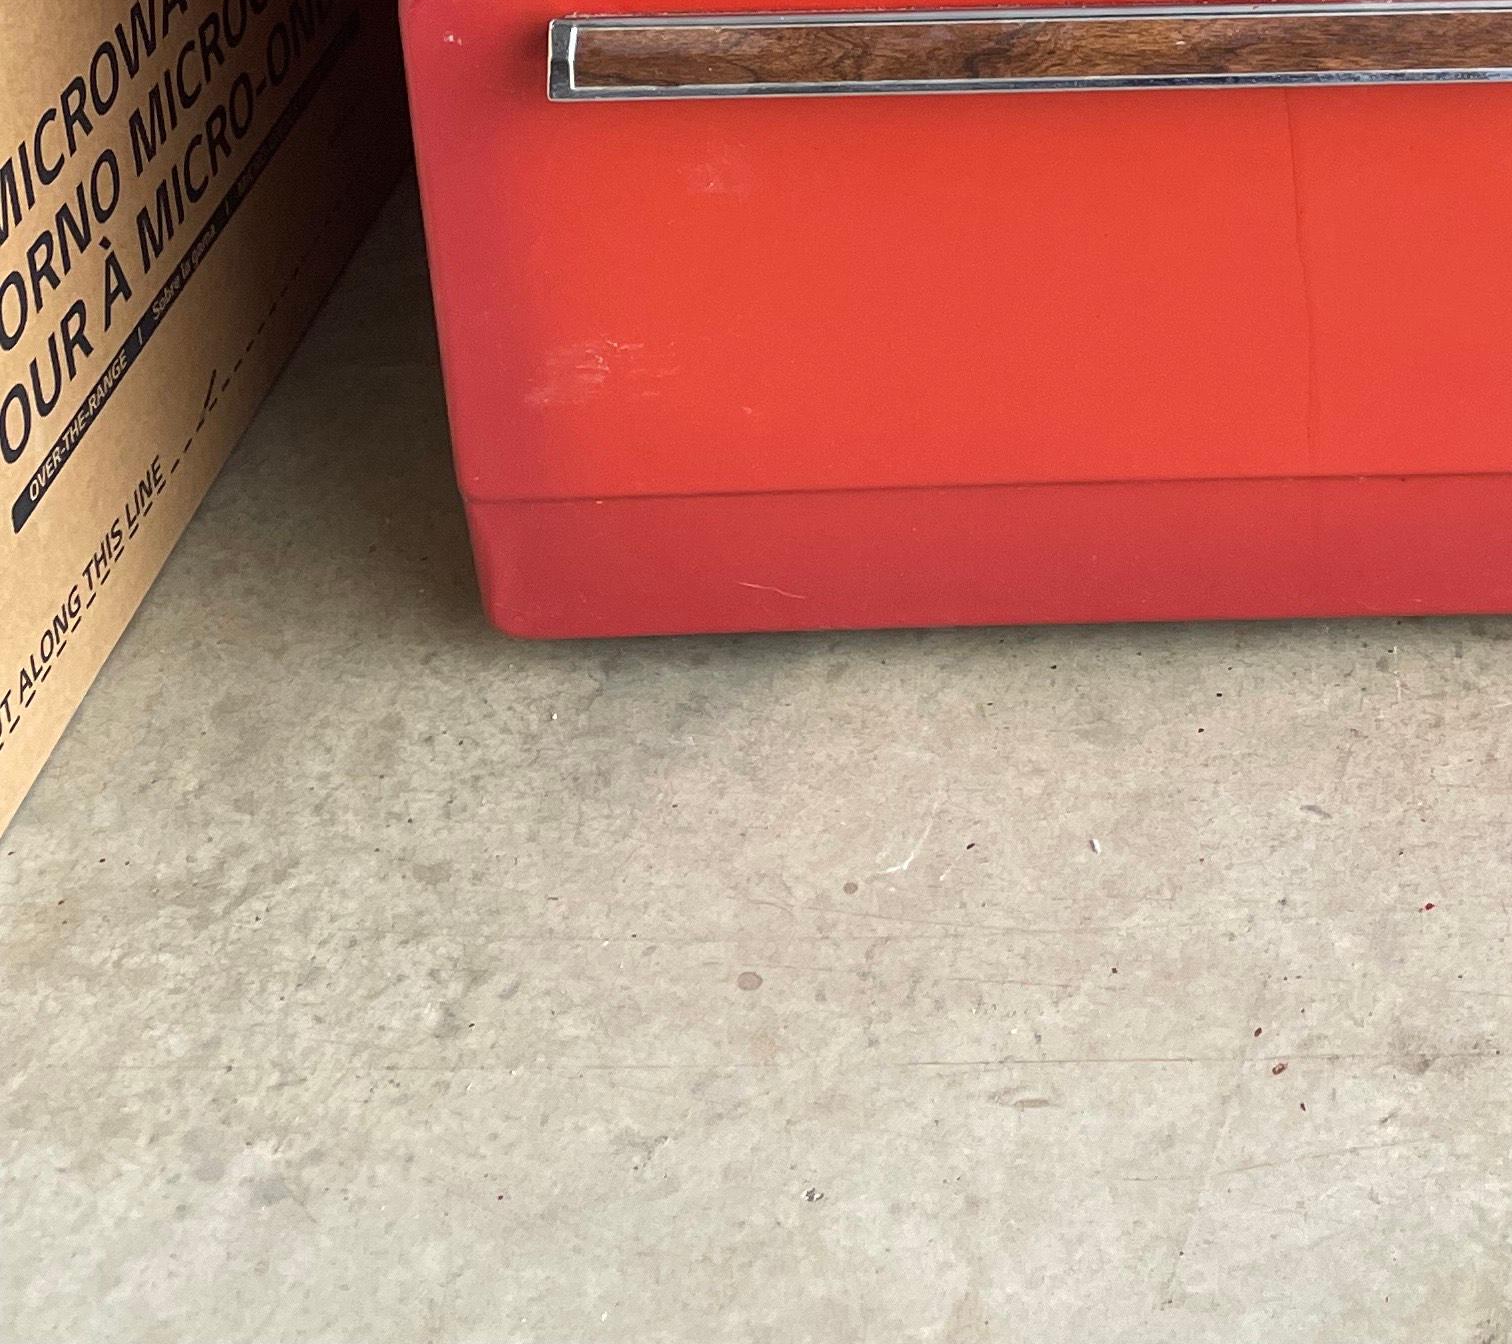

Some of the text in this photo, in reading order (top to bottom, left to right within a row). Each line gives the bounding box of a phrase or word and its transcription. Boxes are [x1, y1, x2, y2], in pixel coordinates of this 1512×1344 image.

[98, 236, 133, 333] À
[29, 355, 128, 502] OVER-THE-RANGE
[20, 584, 82, 705] ALONG
[82, 518, 123, 592] THIS
[124, 454, 165, 530] LINE
